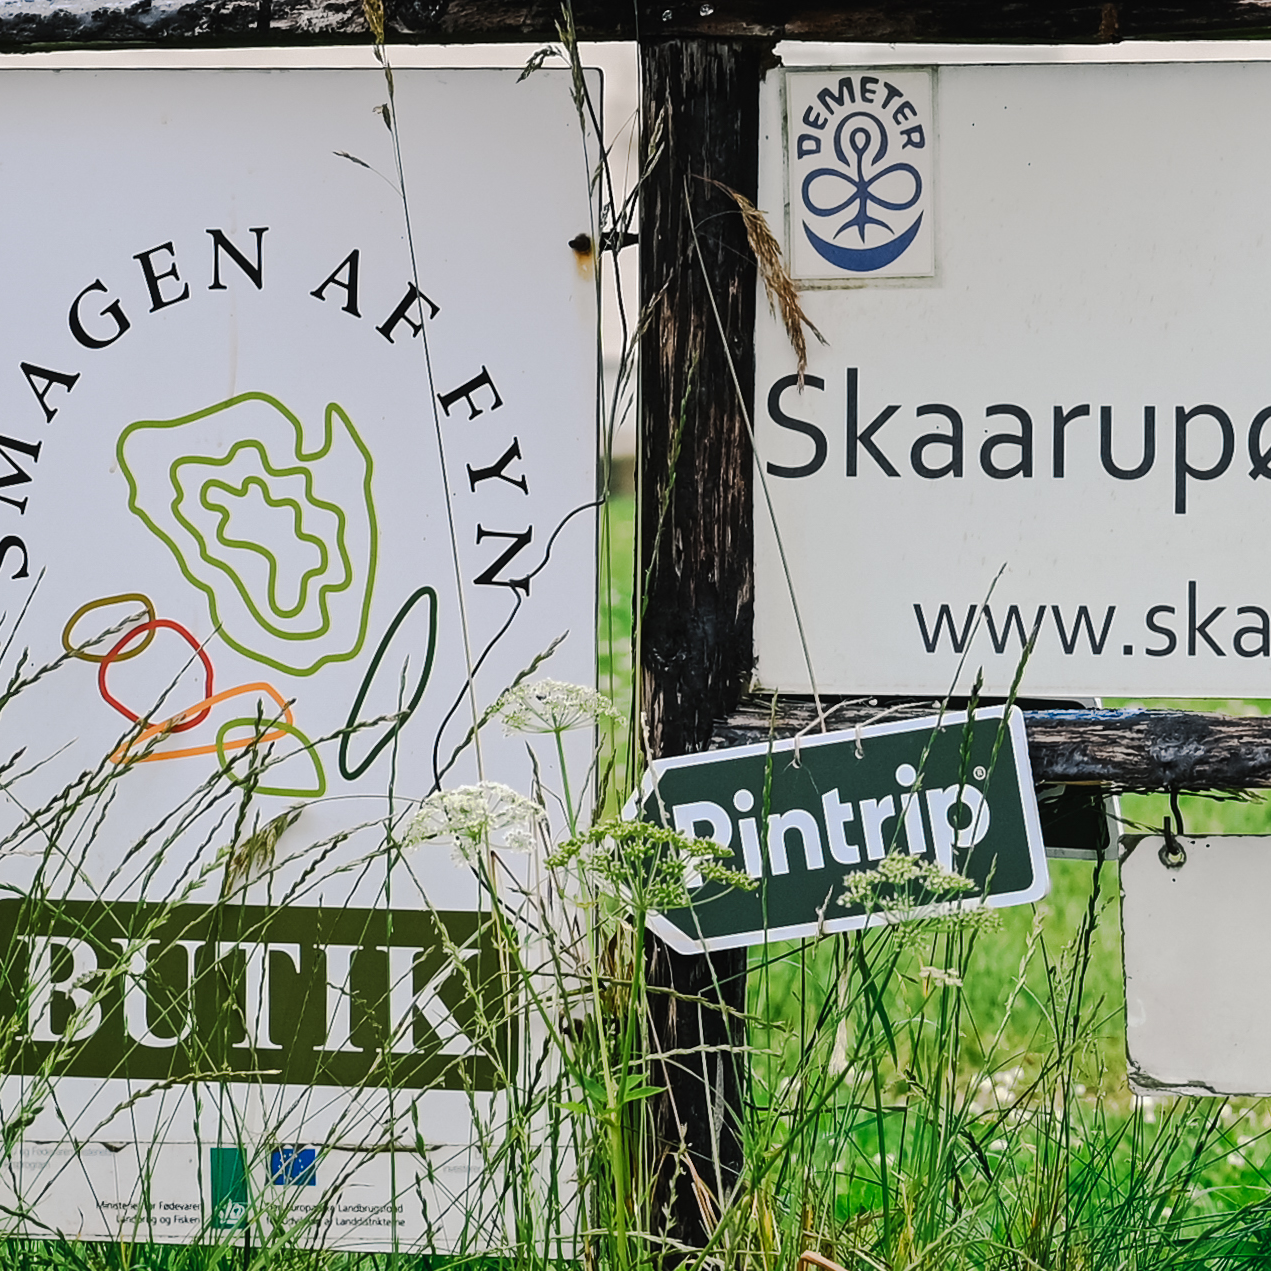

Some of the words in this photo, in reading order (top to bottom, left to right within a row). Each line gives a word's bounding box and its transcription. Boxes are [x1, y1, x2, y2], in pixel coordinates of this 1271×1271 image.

[796, 75, 926, 160] DEMETER
[311, 248, 441, 344] AF
[437, 365, 533, 598] FYN
[671, 763, 991, 889] Pintrip
[16, 934, 488, 1057] BUTIK
